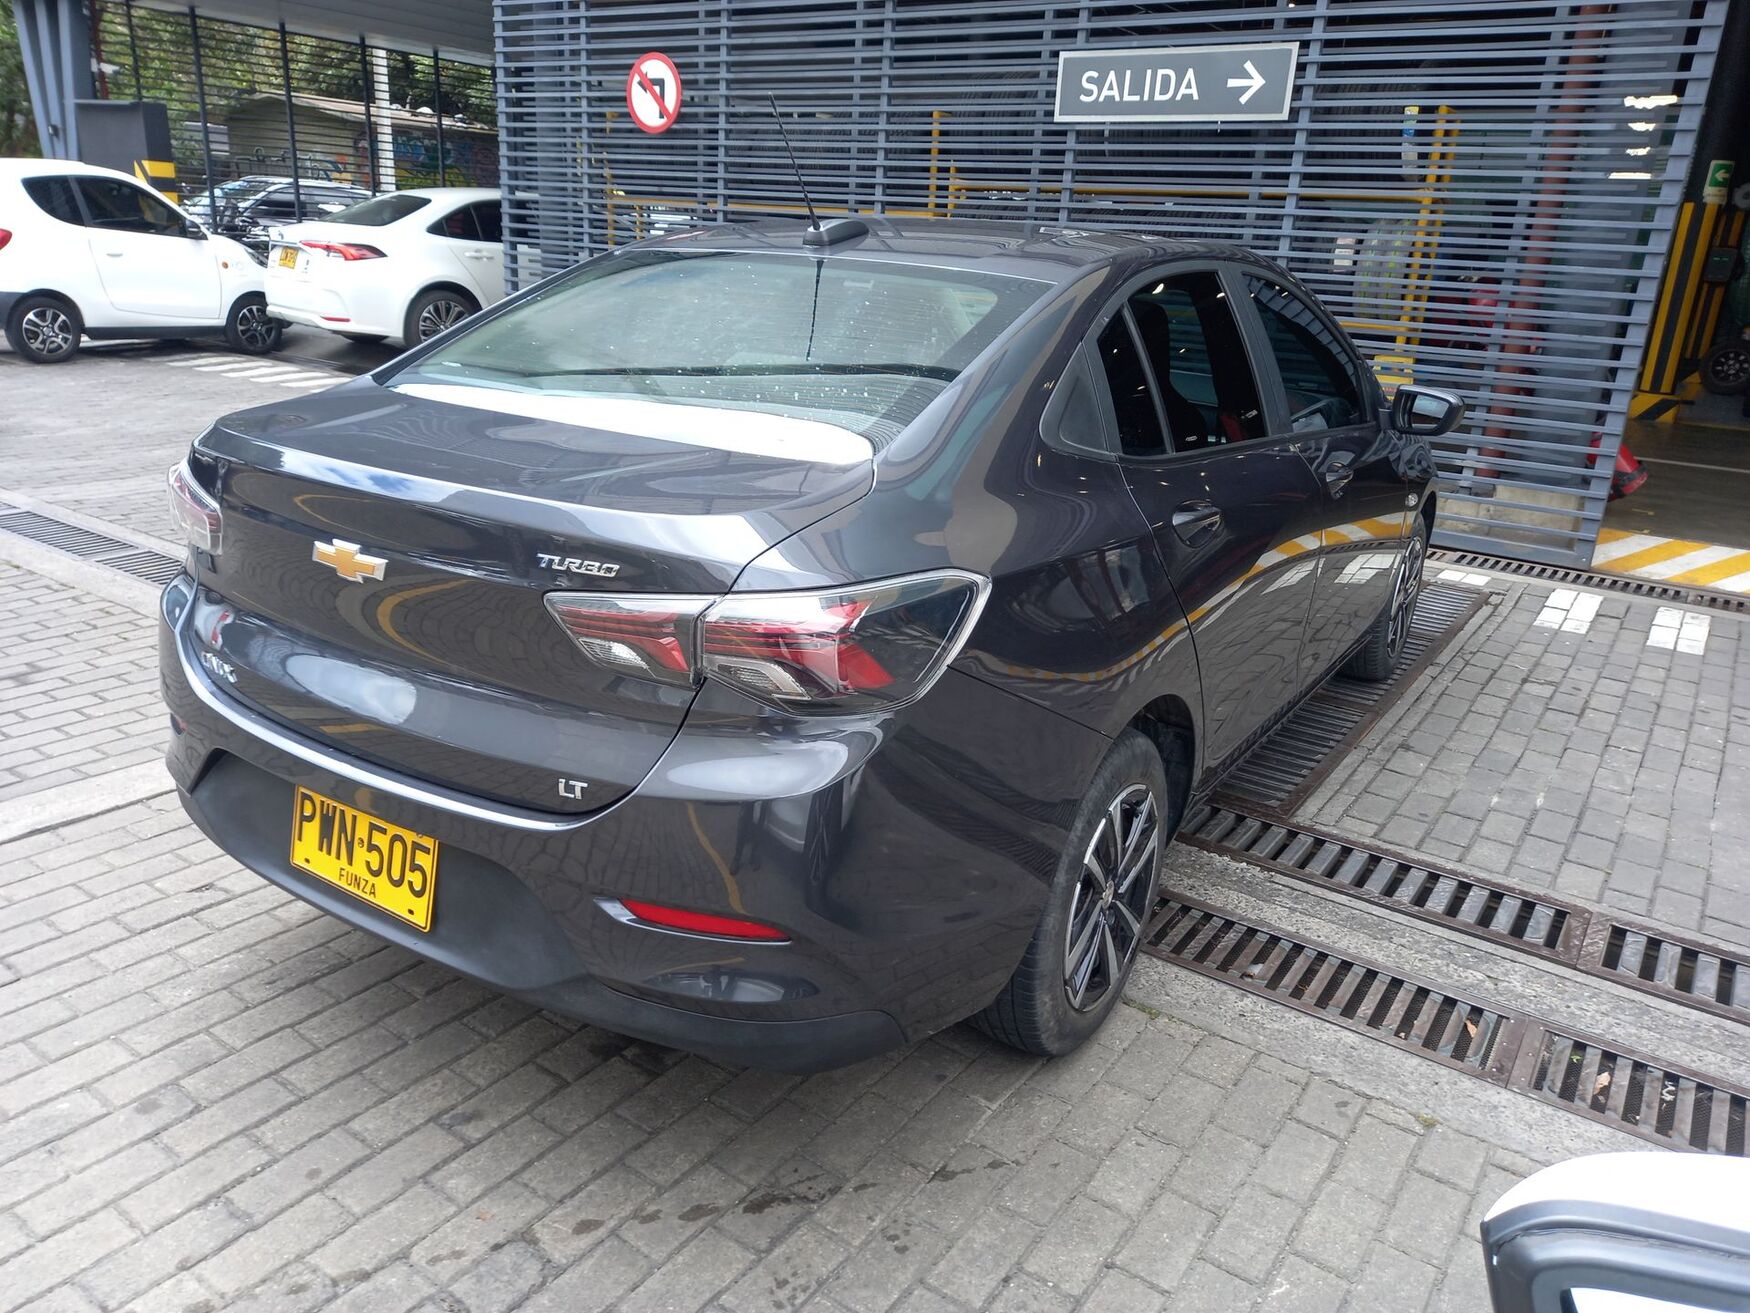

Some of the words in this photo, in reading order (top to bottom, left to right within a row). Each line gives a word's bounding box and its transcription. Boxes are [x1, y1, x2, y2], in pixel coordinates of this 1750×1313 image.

[1079, 67, 1199, 102] SALIDA
[536, 553, 620, 578] TURBO
[558, 778, 588, 800] LT
[297, 791, 357, 867] PWN
[364, 820, 431, 899] 505
[339, 867, 377, 899] FUNZA
